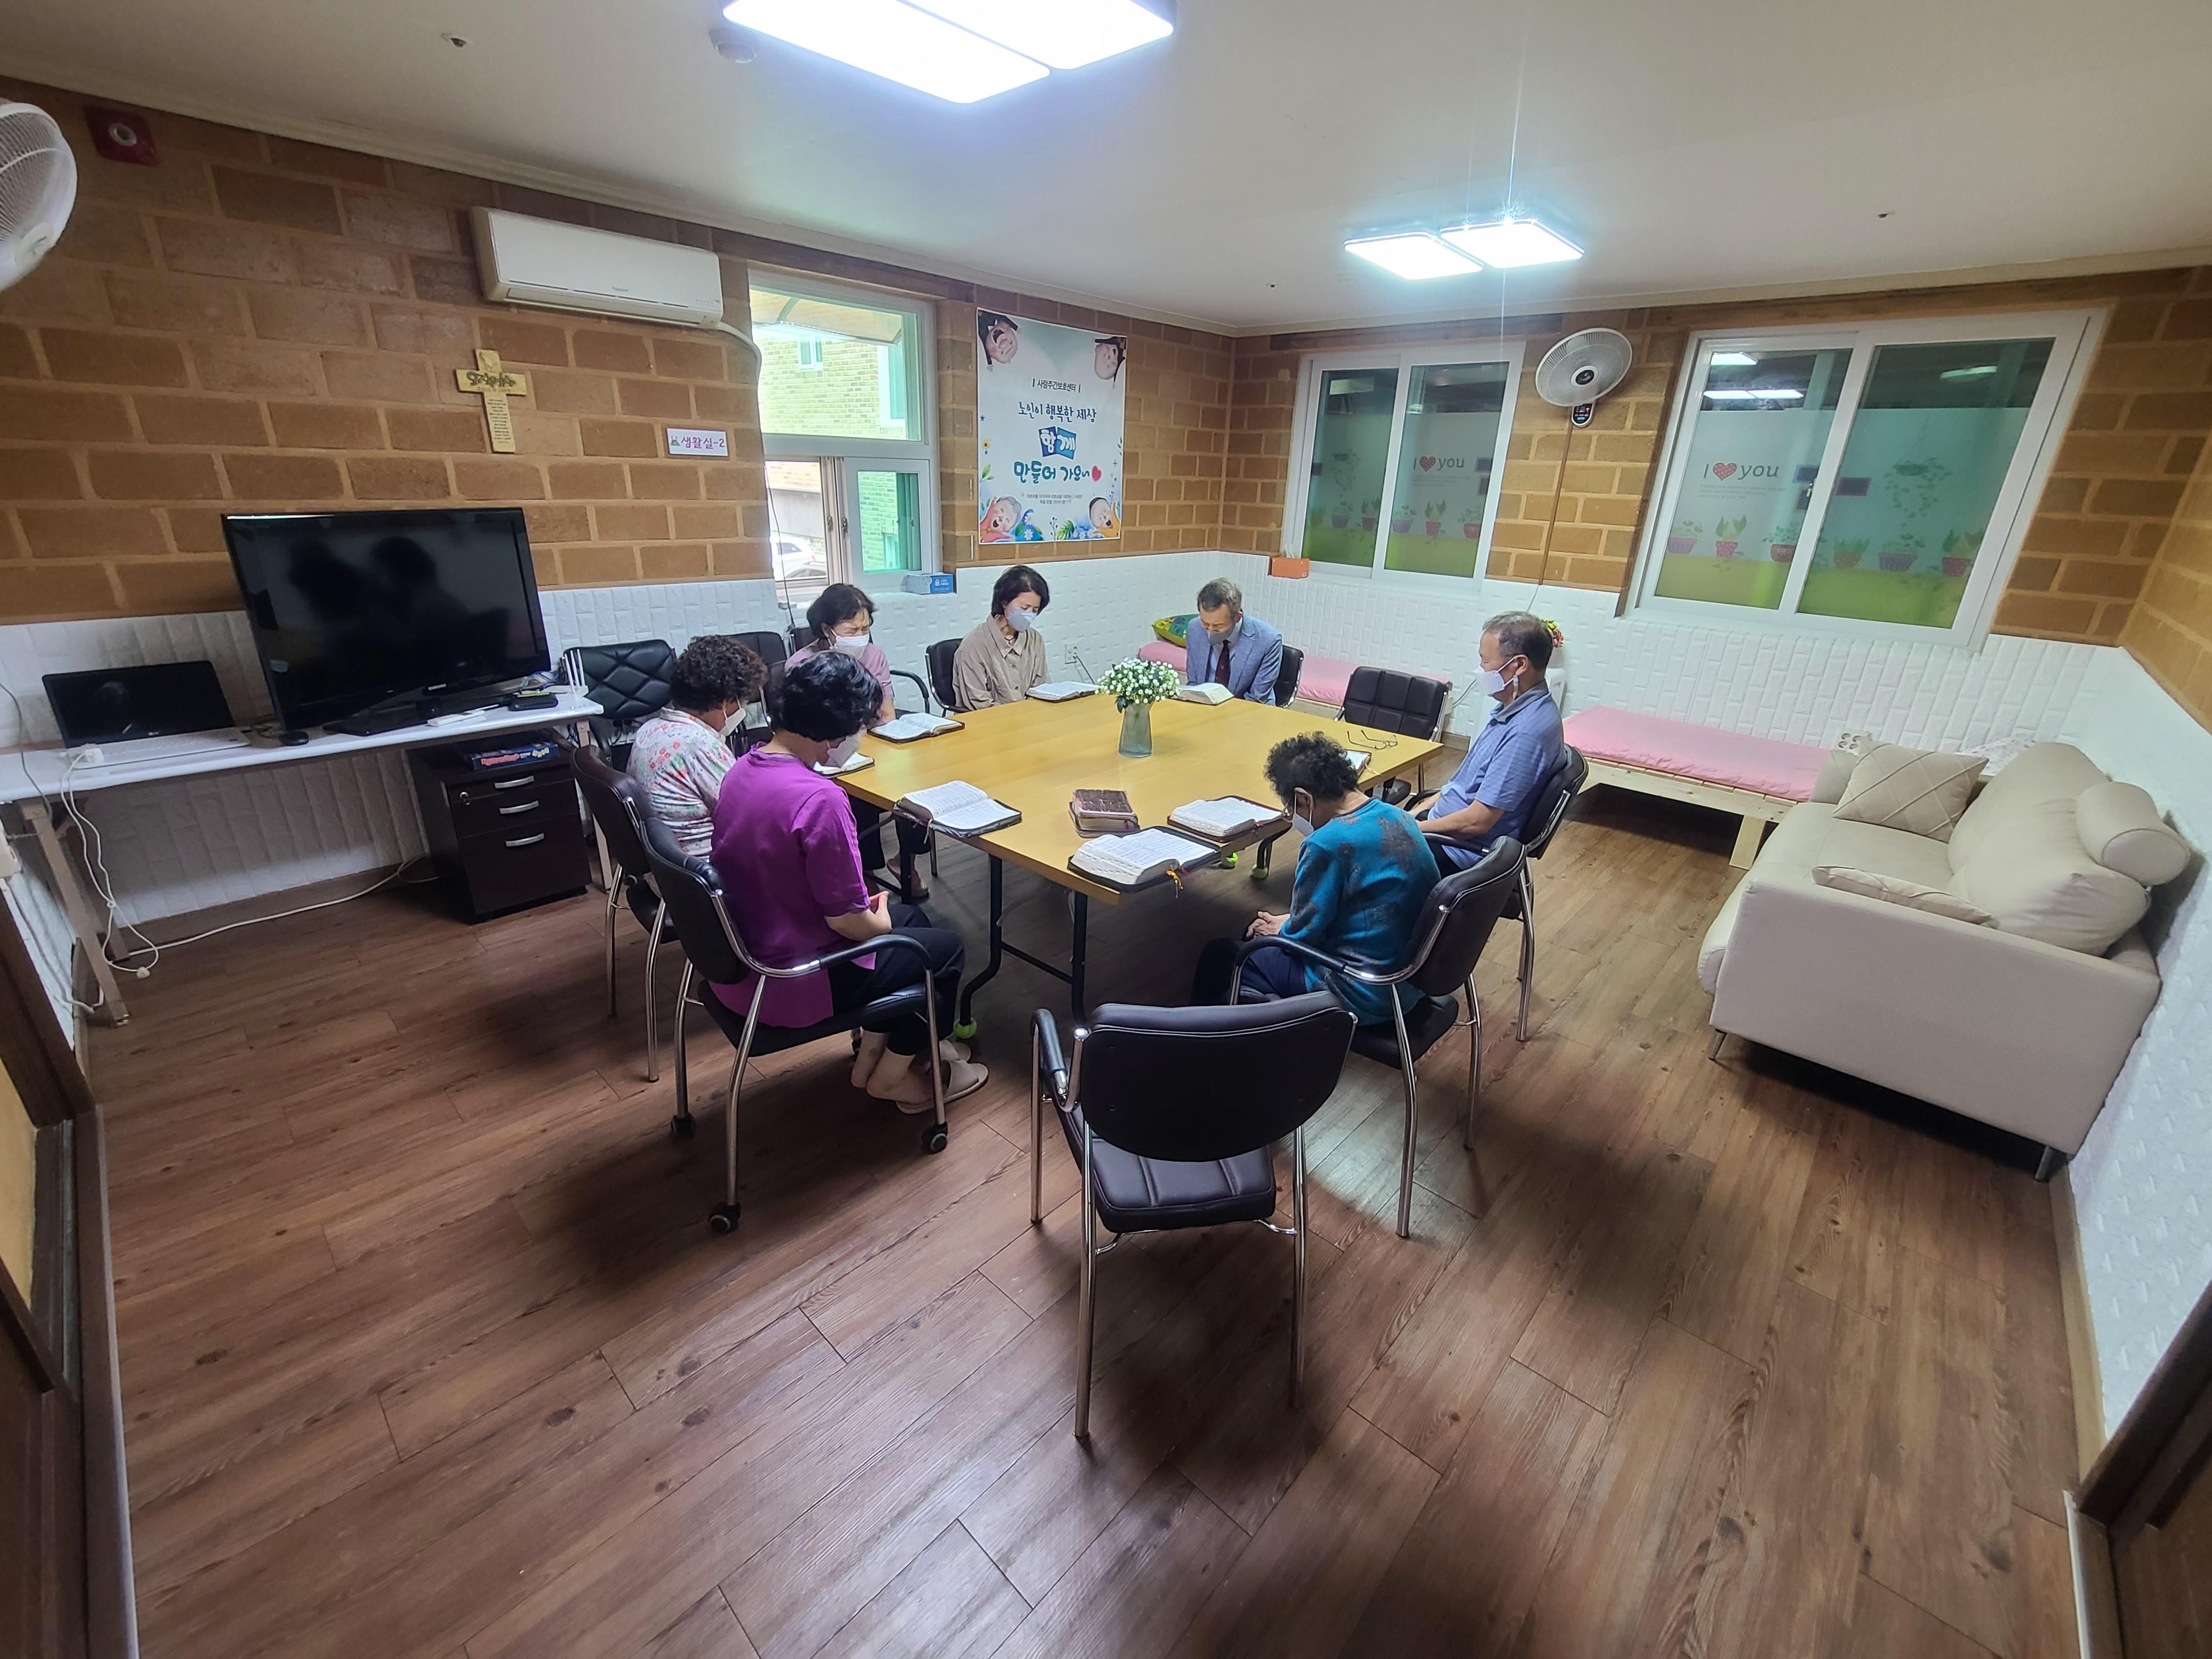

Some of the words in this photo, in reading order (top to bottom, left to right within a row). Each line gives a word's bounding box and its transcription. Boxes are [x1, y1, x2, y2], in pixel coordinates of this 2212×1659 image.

[1037, 379, 1076, 392] 사랑주간보호센터
[1018, 401, 1043, 419] 노인이
[1046, 403, 1074, 422] 행복한
[1076, 408, 1097, 422] 세상
[681, 437, 725, 449] 생활실-2
[1040, 429, 1076, 453] 함께
[1014, 460, 1056, 484] 만들어
[1436, 458, 1465, 471] you
[1737, 465, 1779, 480] you
